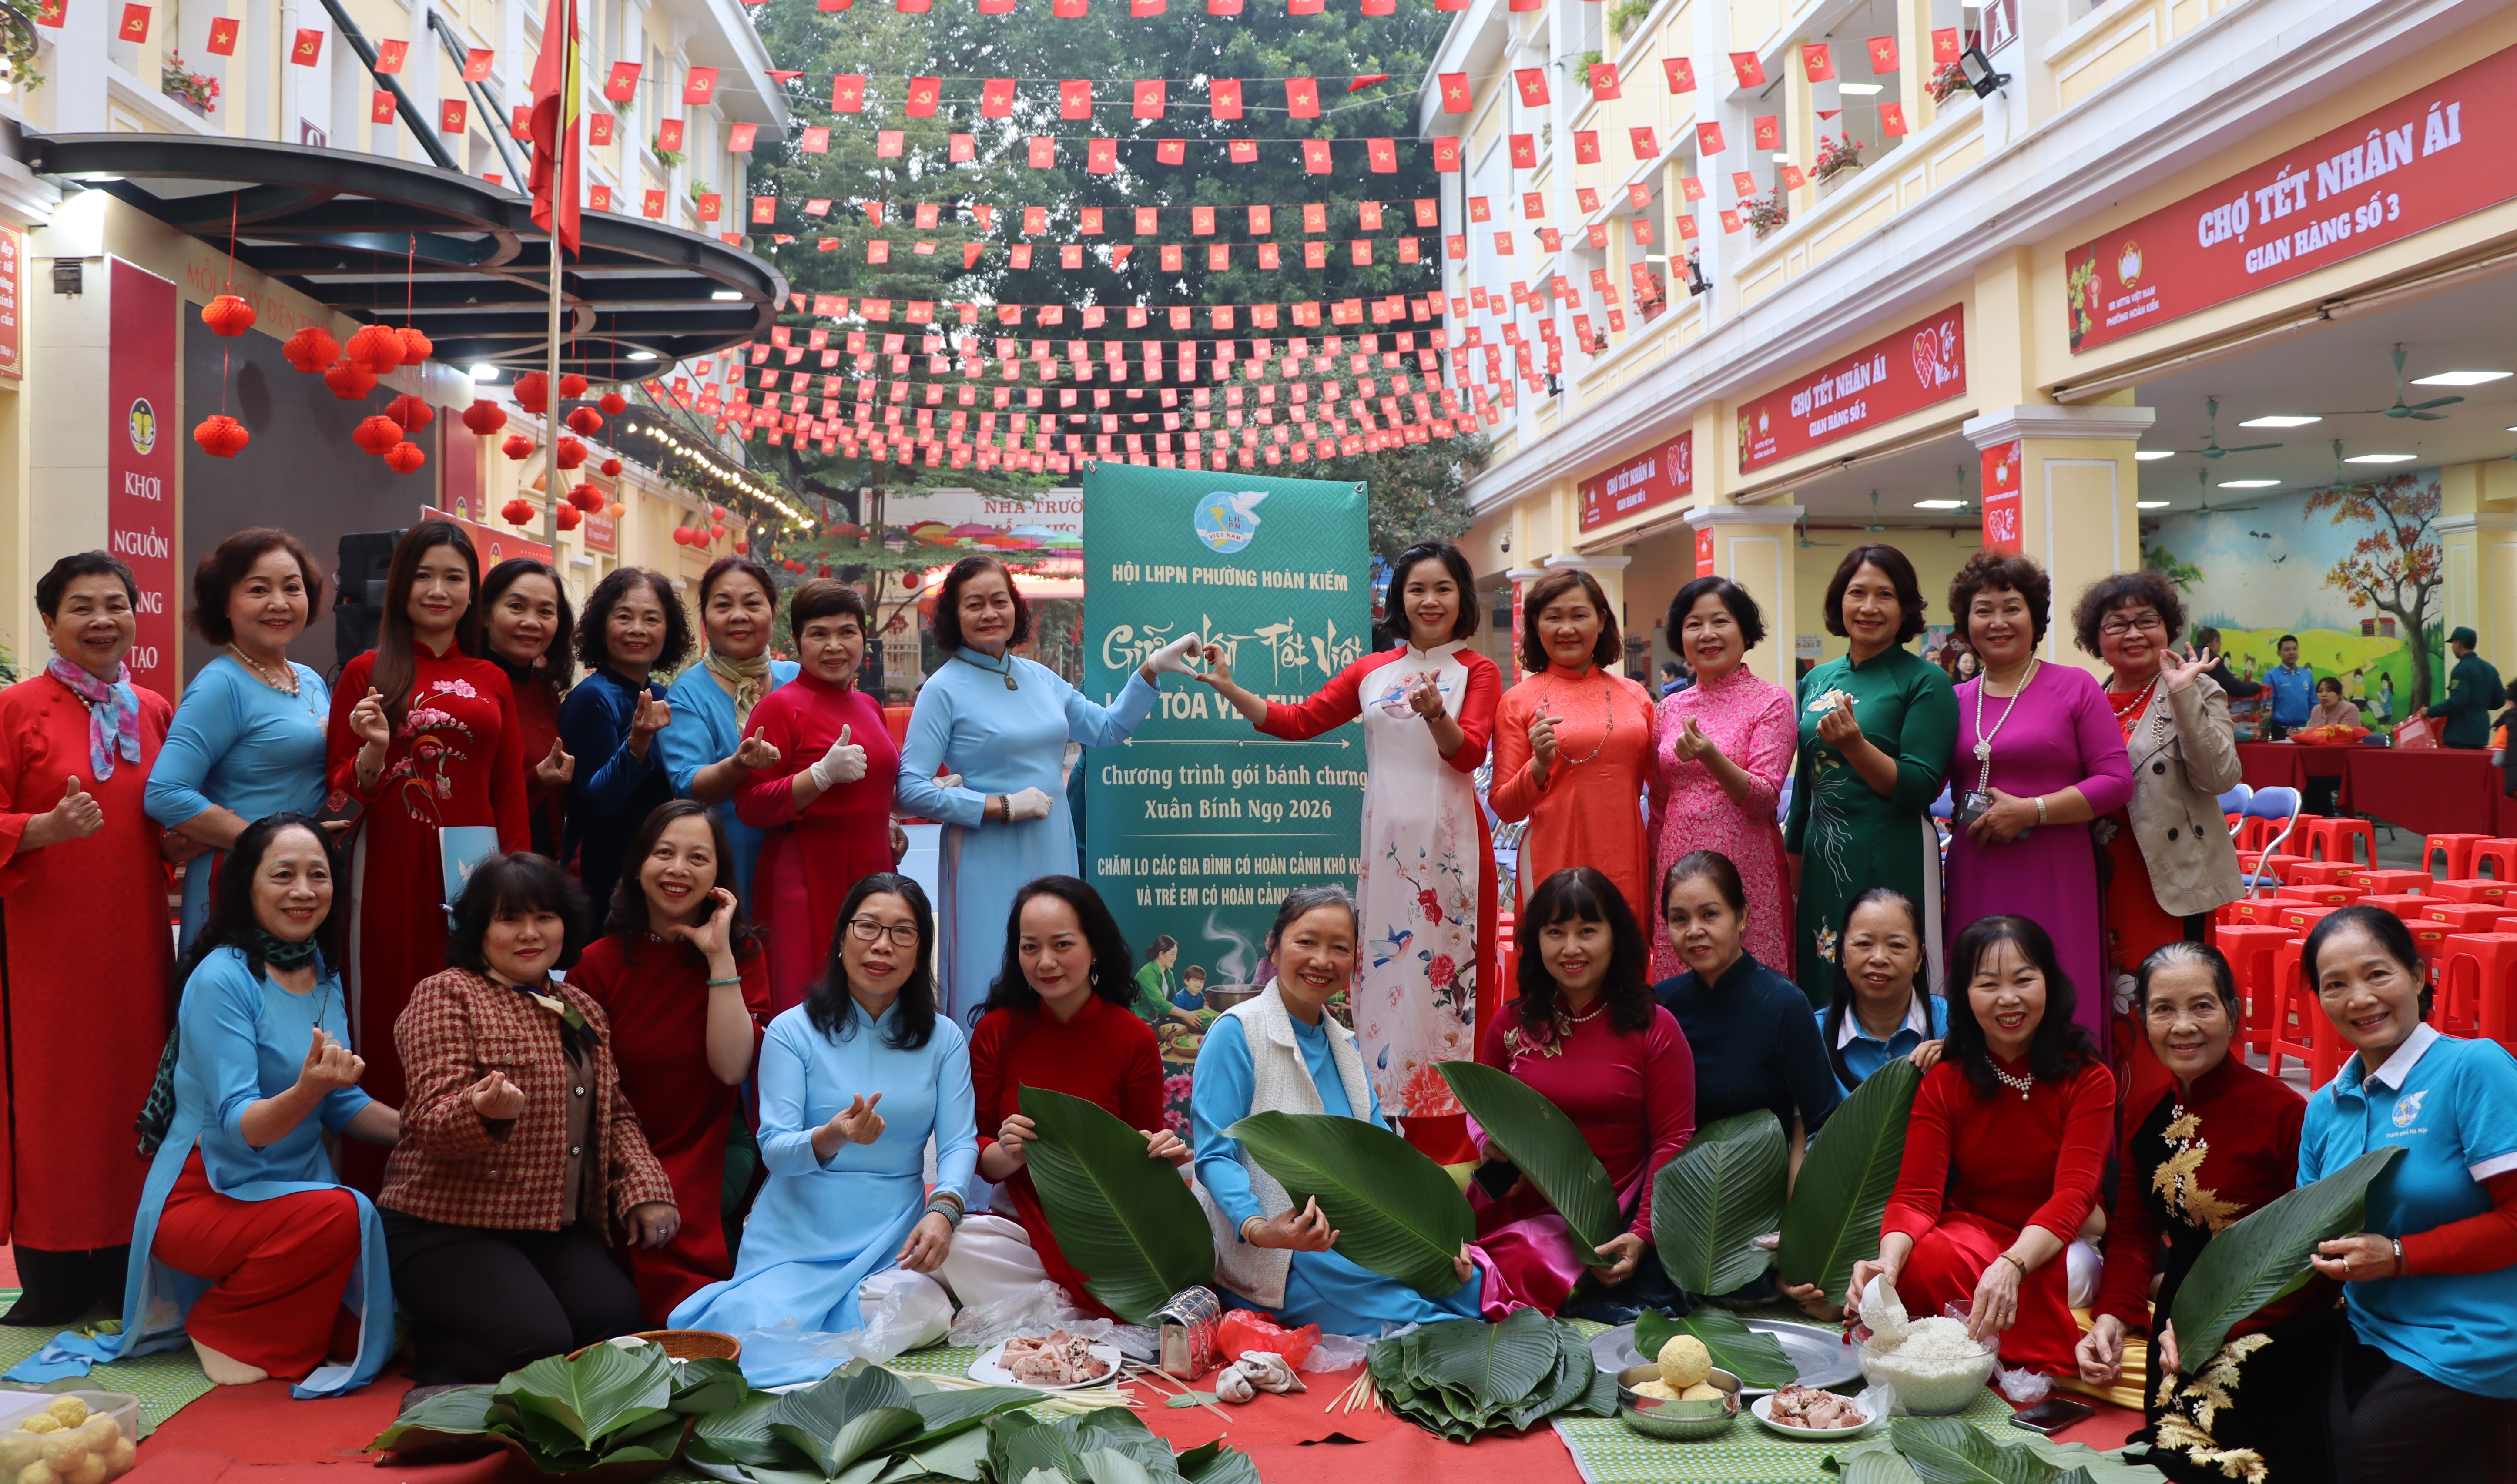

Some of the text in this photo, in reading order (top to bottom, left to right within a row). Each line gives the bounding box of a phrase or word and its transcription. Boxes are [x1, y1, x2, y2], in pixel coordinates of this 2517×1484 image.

[1991, 0, 2012, 51] A
[2198, 100, 2461, 248] CHỢ TẾT NHÂN ÁI
[2245, 190, 2400, 274] GIAN HÀNG SỐ 3
[2131, 289, 2142, 303] VIỆT
[2142, 285, 2156, 299] NAM
[2106, 298, 2159, 327] PHƯỜNG HOÀN KIẾM
[1790, 353, 1887, 418] CHỢ TẾT NHÂN ÁI
[1809, 399, 1867, 438] GIAN HÀNG SỐ 2
[1606, 457, 1656, 497] CHỢ TẾT NHÂN ÁI
[114, 526, 169, 559] NGUỒN
[1112, 560, 1348, 591] HỘI LHPN PHƯỜNG HOÀN KIẾM
[131, 646, 158, 674] TẠO
[1254, 616, 1310, 687] Tết
[1159, 685, 1208, 719] TỎA
[1102, 763, 1368, 791] Chương trình gói bánh chưng
[1144, 797, 1332, 823] Xuân Bính Ngọ 2026
[1098, 854, 1131, 875] CHĂM
[1135, 858, 1149, 875] LO
[1153, 854, 1176, 875] CÁC
[1180, 858, 1200, 875] GIA
[1203, 854, 1231, 875] ĐÌNH
[1235, 854, 1250, 875] CÓ
[1254, 854, 1286, 874] HOÀN
[1290, 851, 1321, 874] CẢNH
[1324, 853, 1346, 874] KHÓ
[1136, 881, 1290, 906] VÀ TRẺ EM CÓ HOÀN CẢNH
